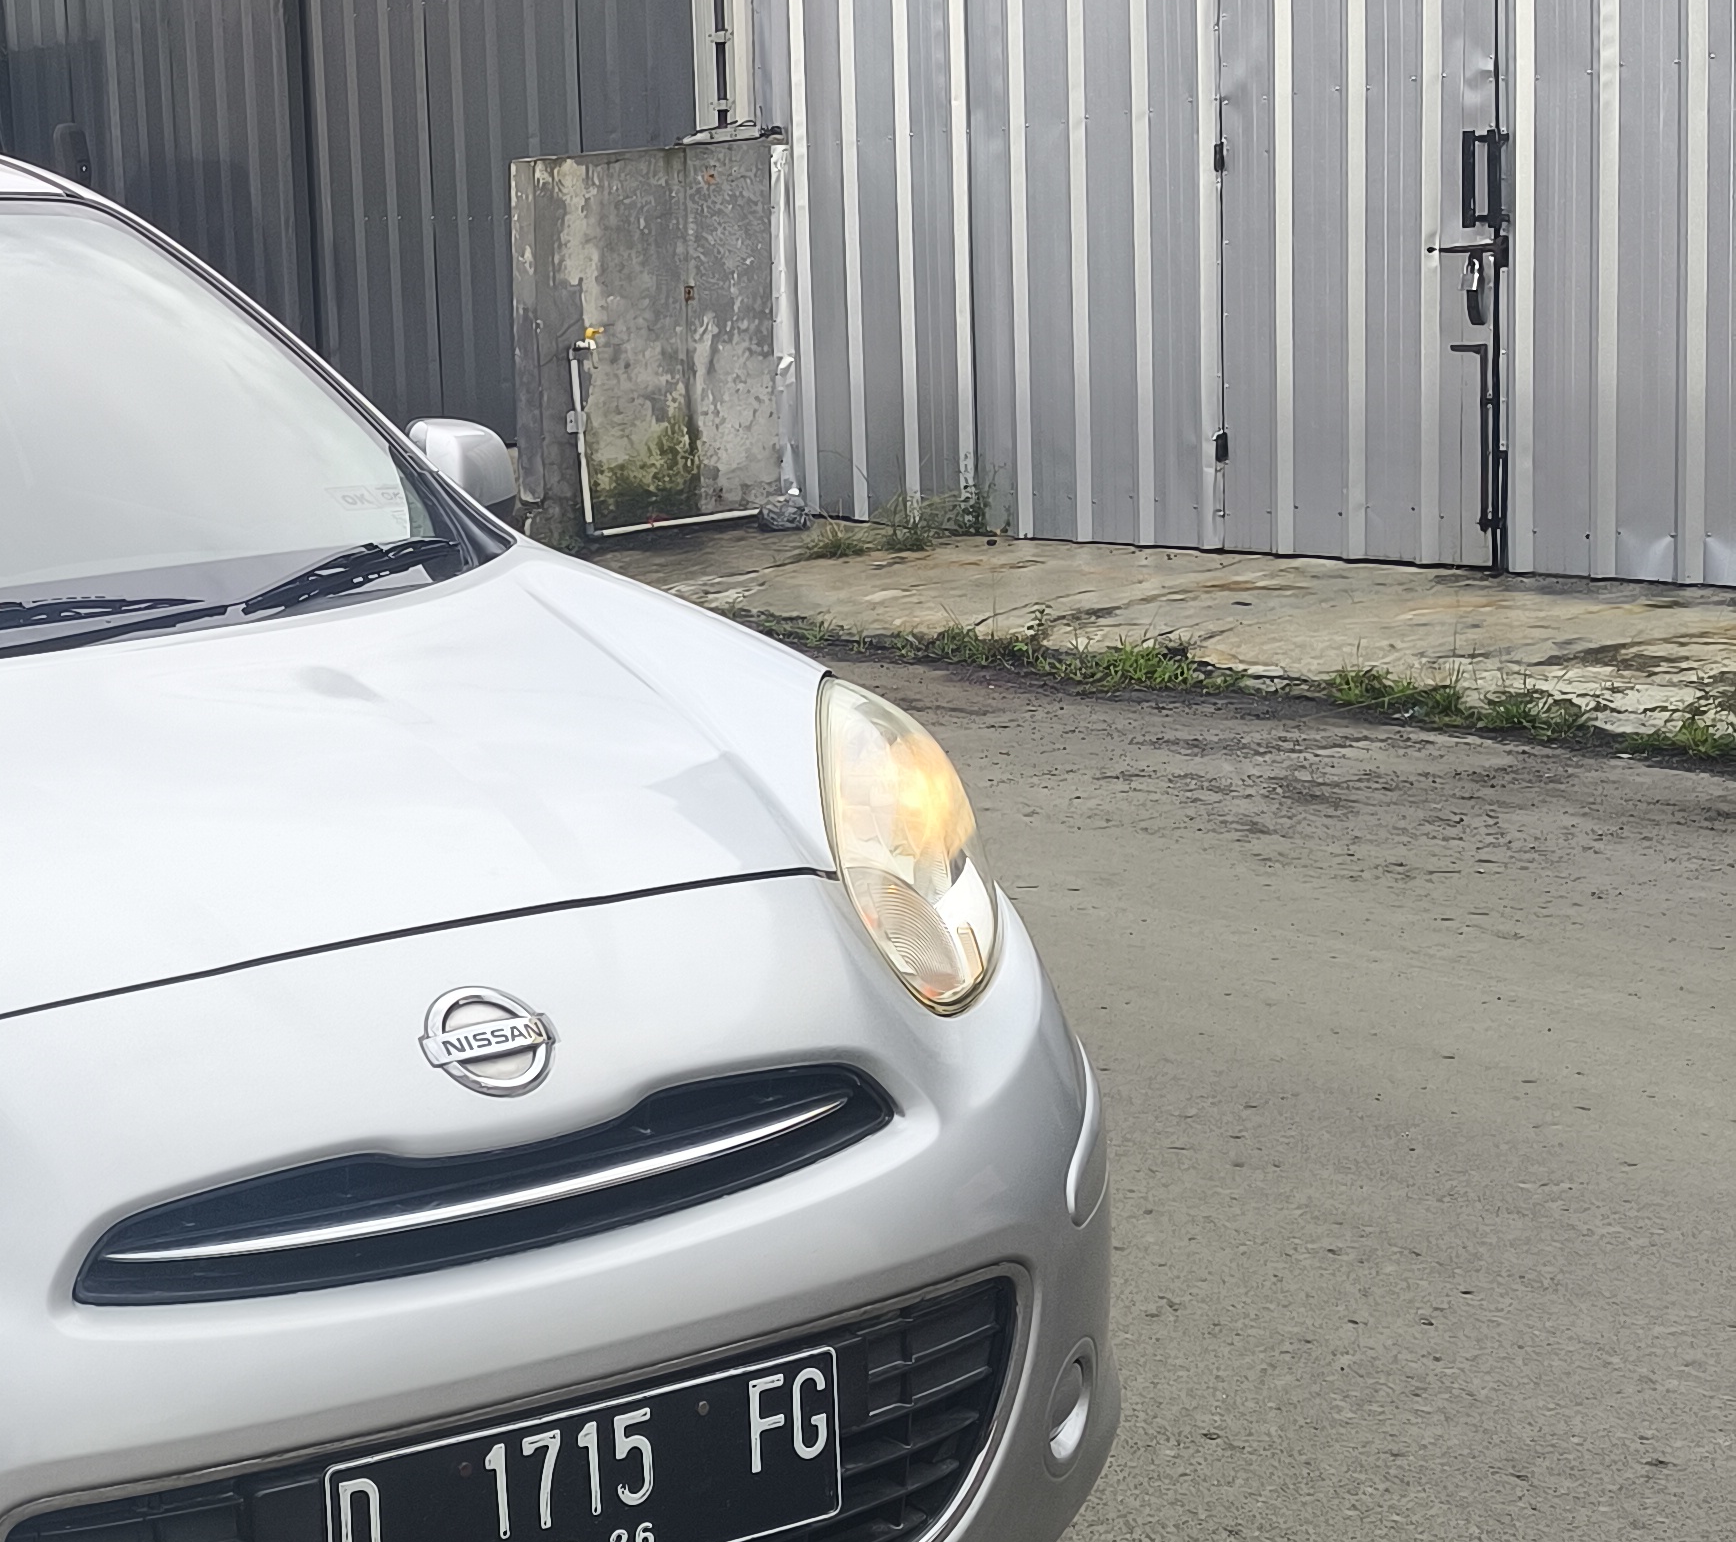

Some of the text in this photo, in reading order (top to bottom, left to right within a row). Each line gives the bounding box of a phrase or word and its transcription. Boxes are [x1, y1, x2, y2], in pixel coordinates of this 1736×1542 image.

[341, 493, 374, 506] OK
[441, 1021, 544, 1057] NISSAN
[484, 1407, 654, 1540] 1715
[749, 1367, 828, 1473] FG
